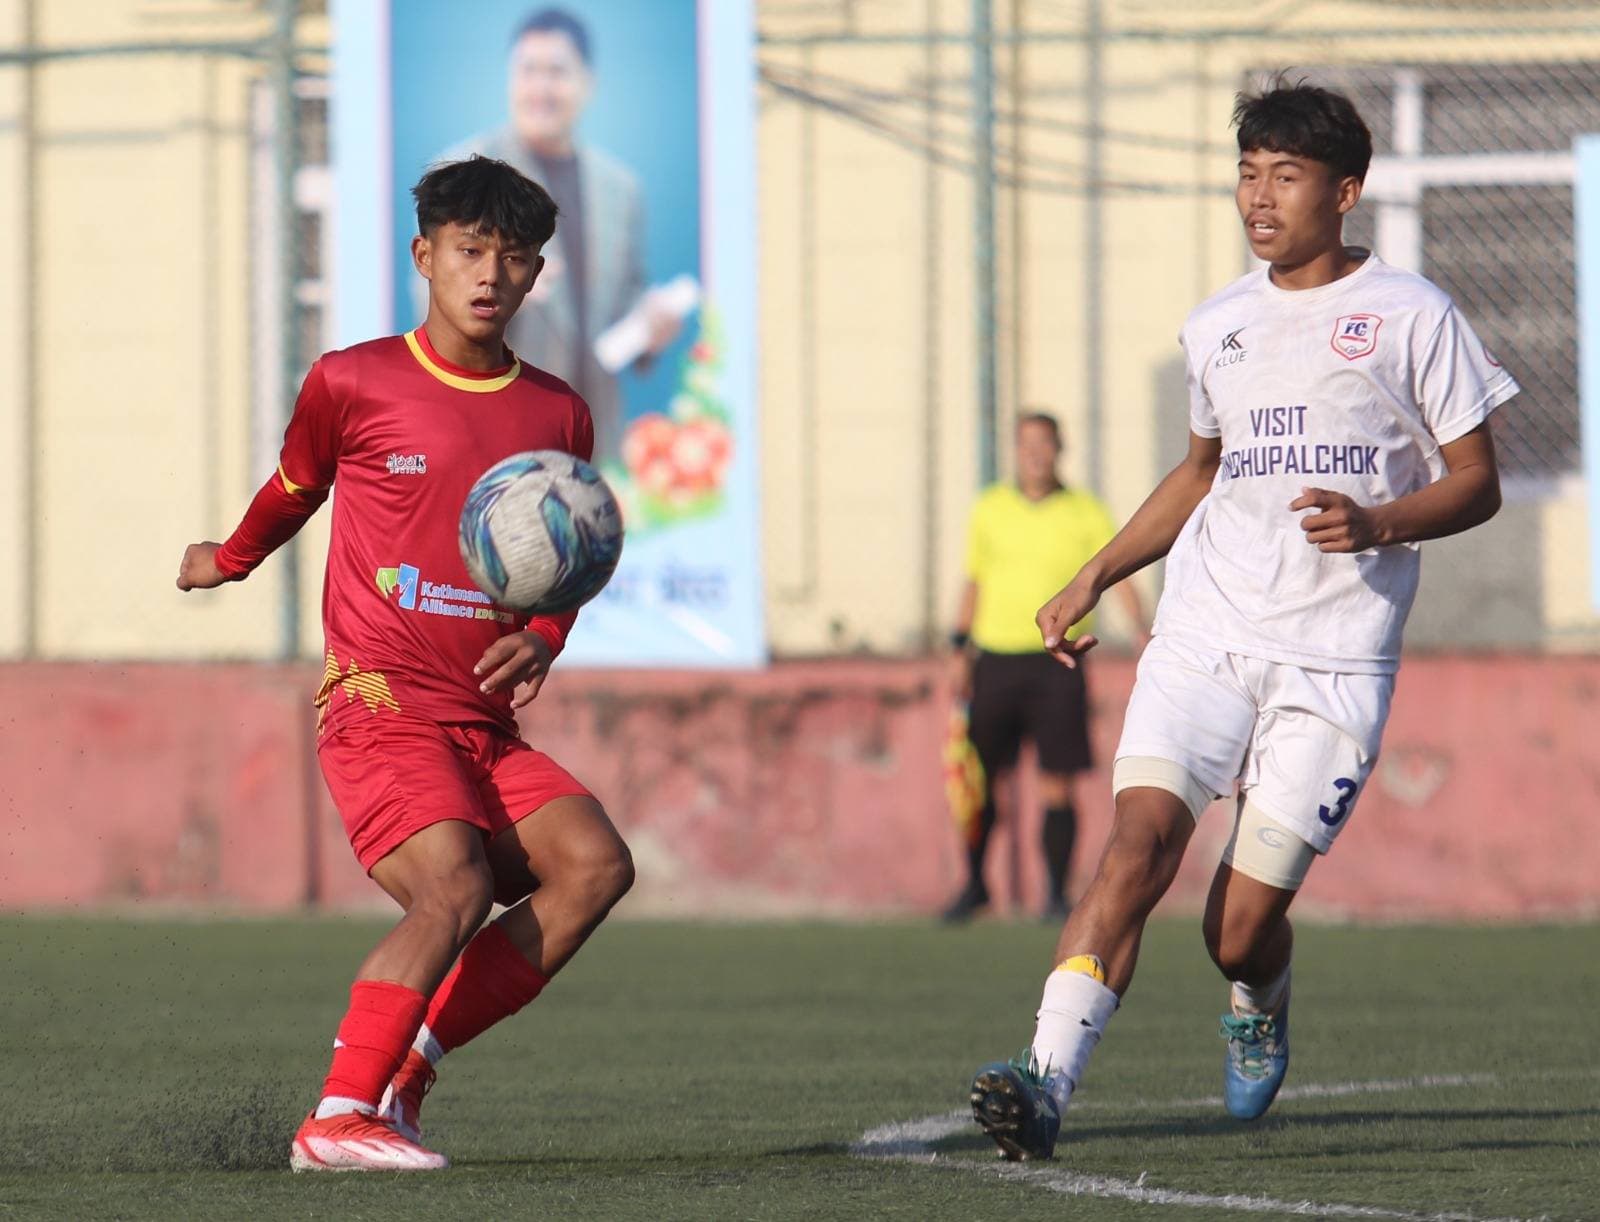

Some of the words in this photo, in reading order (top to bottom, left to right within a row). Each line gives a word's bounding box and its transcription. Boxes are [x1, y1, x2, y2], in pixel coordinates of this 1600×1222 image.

[1344, 321, 1368, 337] FC
[1215, 350, 1248, 369] KLUE
[1250, 406, 1308, 438] VISIT
[1220, 445, 1380, 483] NDHUPALCHOK
[418, 598, 474, 619] Alliance
[1319, 777, 1358, 826] 3
